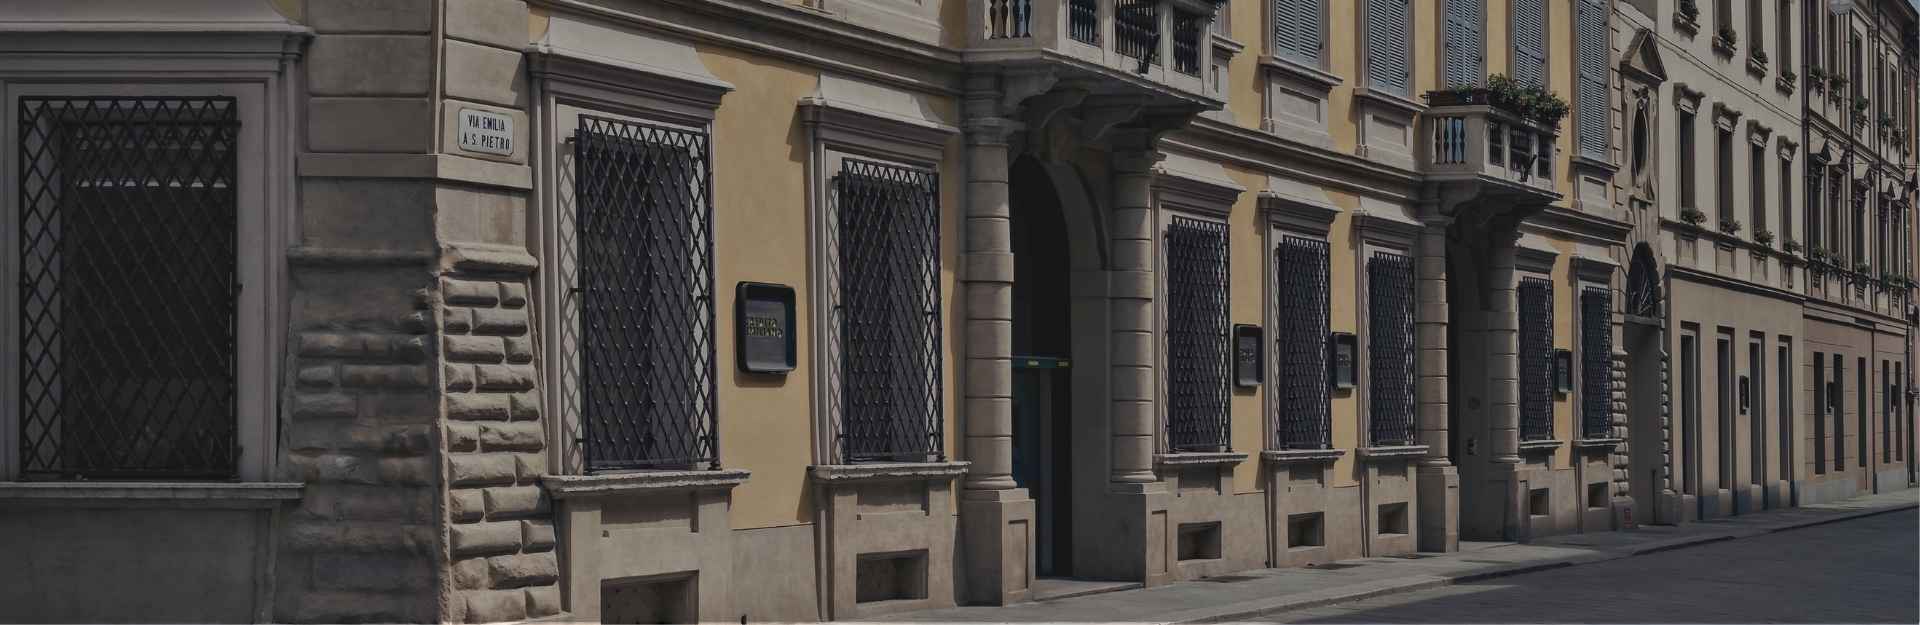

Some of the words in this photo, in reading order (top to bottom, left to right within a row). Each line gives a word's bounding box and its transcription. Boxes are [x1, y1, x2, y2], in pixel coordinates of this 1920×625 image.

[468, 114, 480, 129] VIA
[483, 116, 505, 131] EMILIA
[463, 131, 468, 145] A
[482, 134, 510, 150] PIETRO
